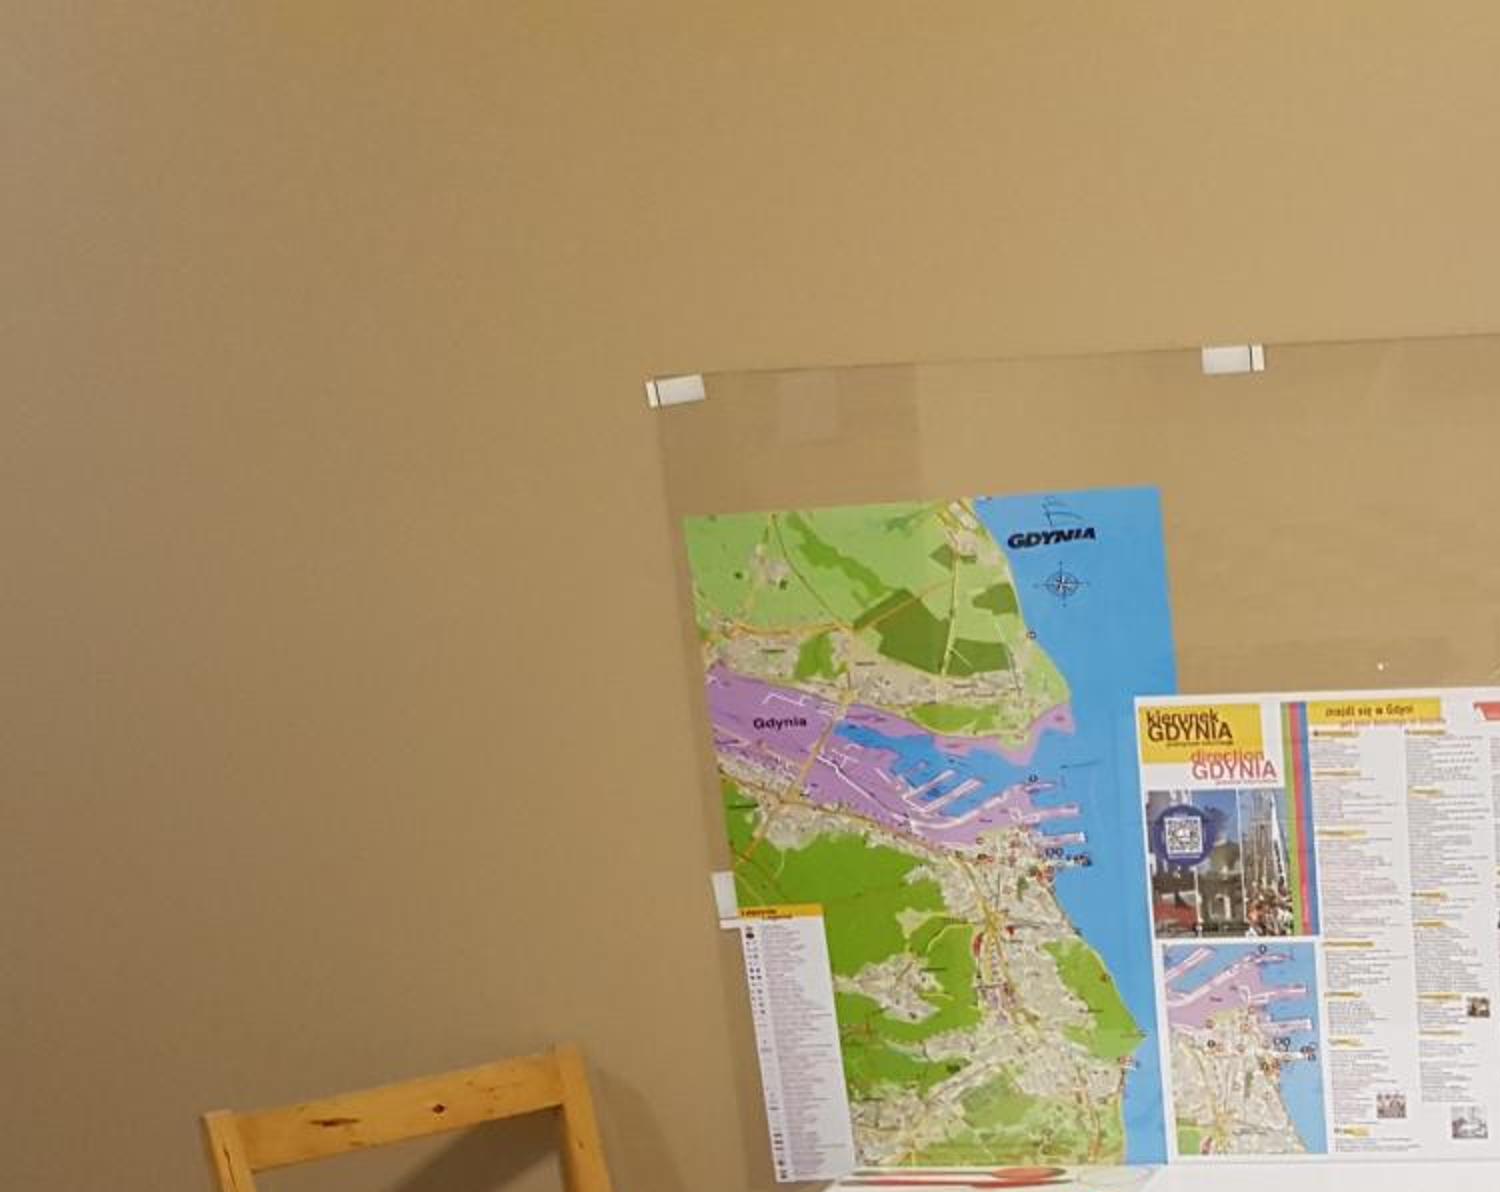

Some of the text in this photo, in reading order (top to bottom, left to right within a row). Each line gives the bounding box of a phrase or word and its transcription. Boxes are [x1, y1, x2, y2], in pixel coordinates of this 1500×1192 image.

[1007, 527, 1096, 550] GDYNIA
[753, 716, 807, 731] Gdynia
[1146, 707, 1219, 724] kierunek
[1148, 721, 1232, 742] GDYNIA
[1191, 747, 1264, 764] direction
[1193, 760, 1277, 780] GDYNIA
